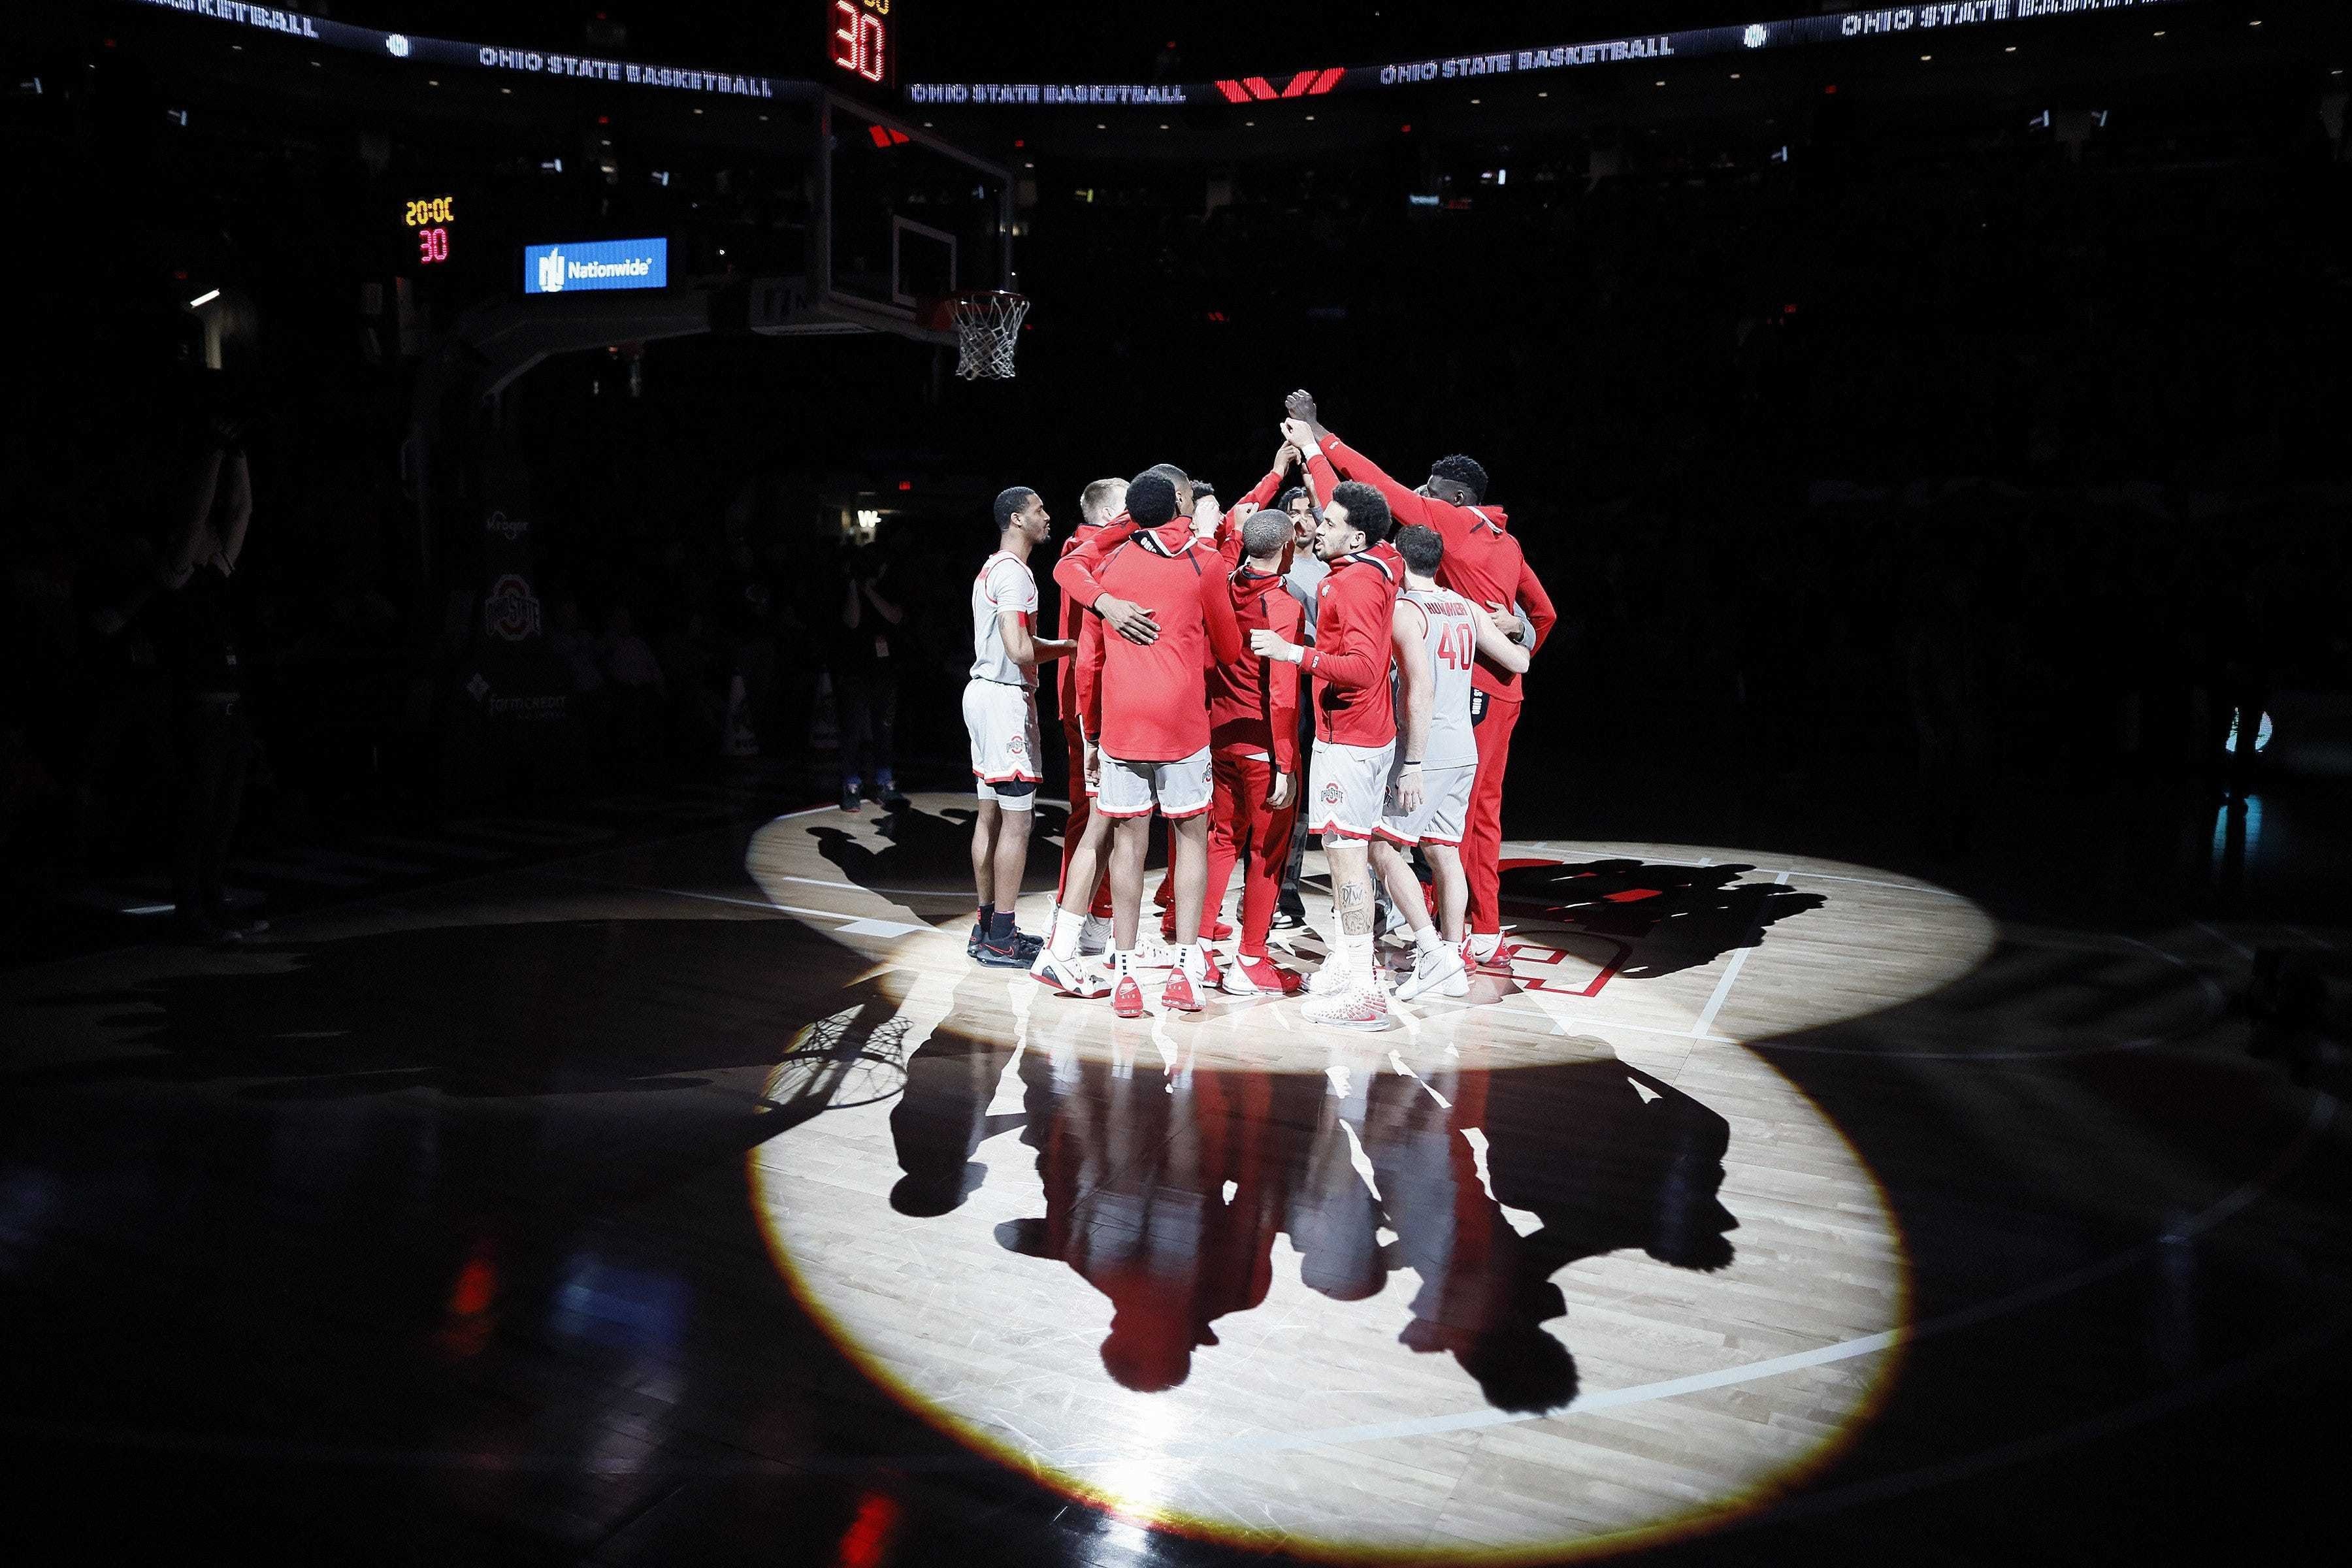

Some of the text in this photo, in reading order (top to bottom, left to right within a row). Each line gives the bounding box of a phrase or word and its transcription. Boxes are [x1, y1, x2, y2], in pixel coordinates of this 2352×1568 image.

[837, 0, 883, 81] 30
[1842, 9, 1914, 35] OHIO
[1920, 0, 2010, 28] STATE
[480, 47, 772, 97] OHIO STATE BASKETBALL
[1380, 37, 1674, 84] OHIO STATE BASKETBALL
[911, 84, 1186, 105] OHIO STATE BASKETBALL
[419, 228, 447, 262] 30
[1437, 623, 1473, 670] 40
